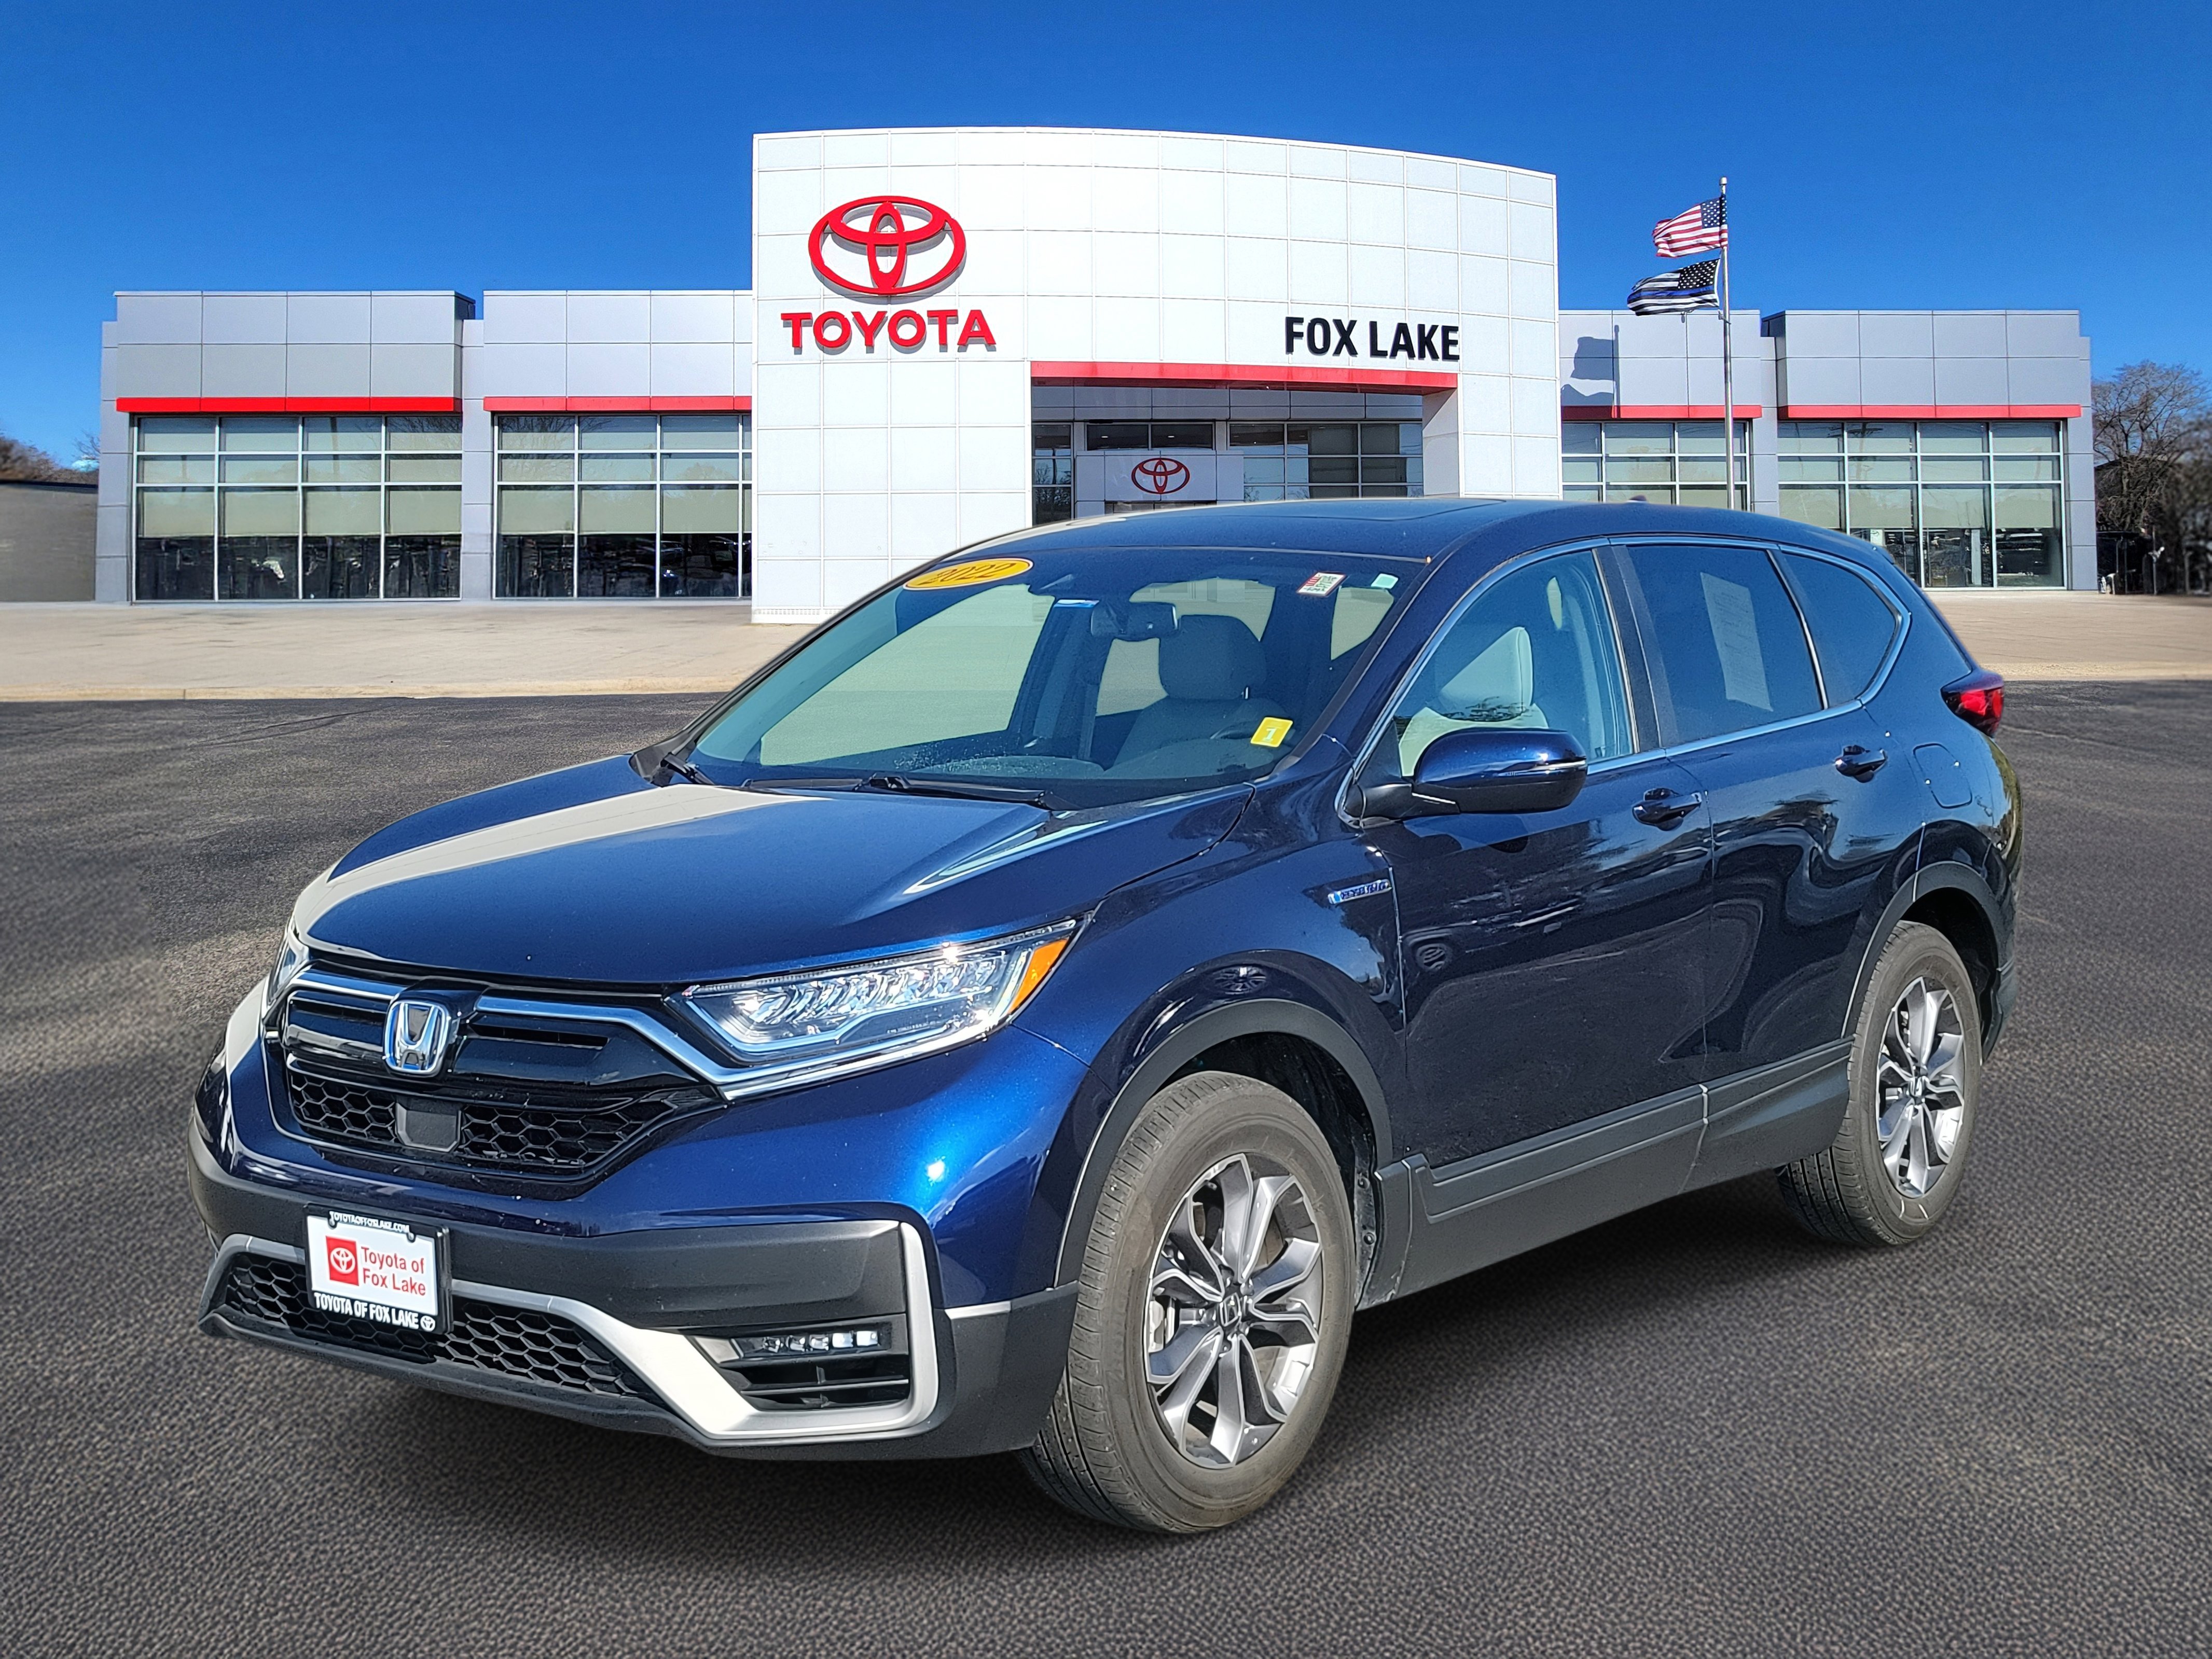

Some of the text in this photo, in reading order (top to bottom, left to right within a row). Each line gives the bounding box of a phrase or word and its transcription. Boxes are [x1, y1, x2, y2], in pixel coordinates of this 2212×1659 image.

[781, 310, 996, 348] TOYOTA
[1285, 316, 1460, 361] FOX LAKE
[917, 563, 1016, 585] 2022
[361, 1246, 424, 1274] Toyota of
[363, 1268, 426, 1296] Fox Lake
[314, 1292, 419, 1330] TOYOTA OF FOX LAKE
